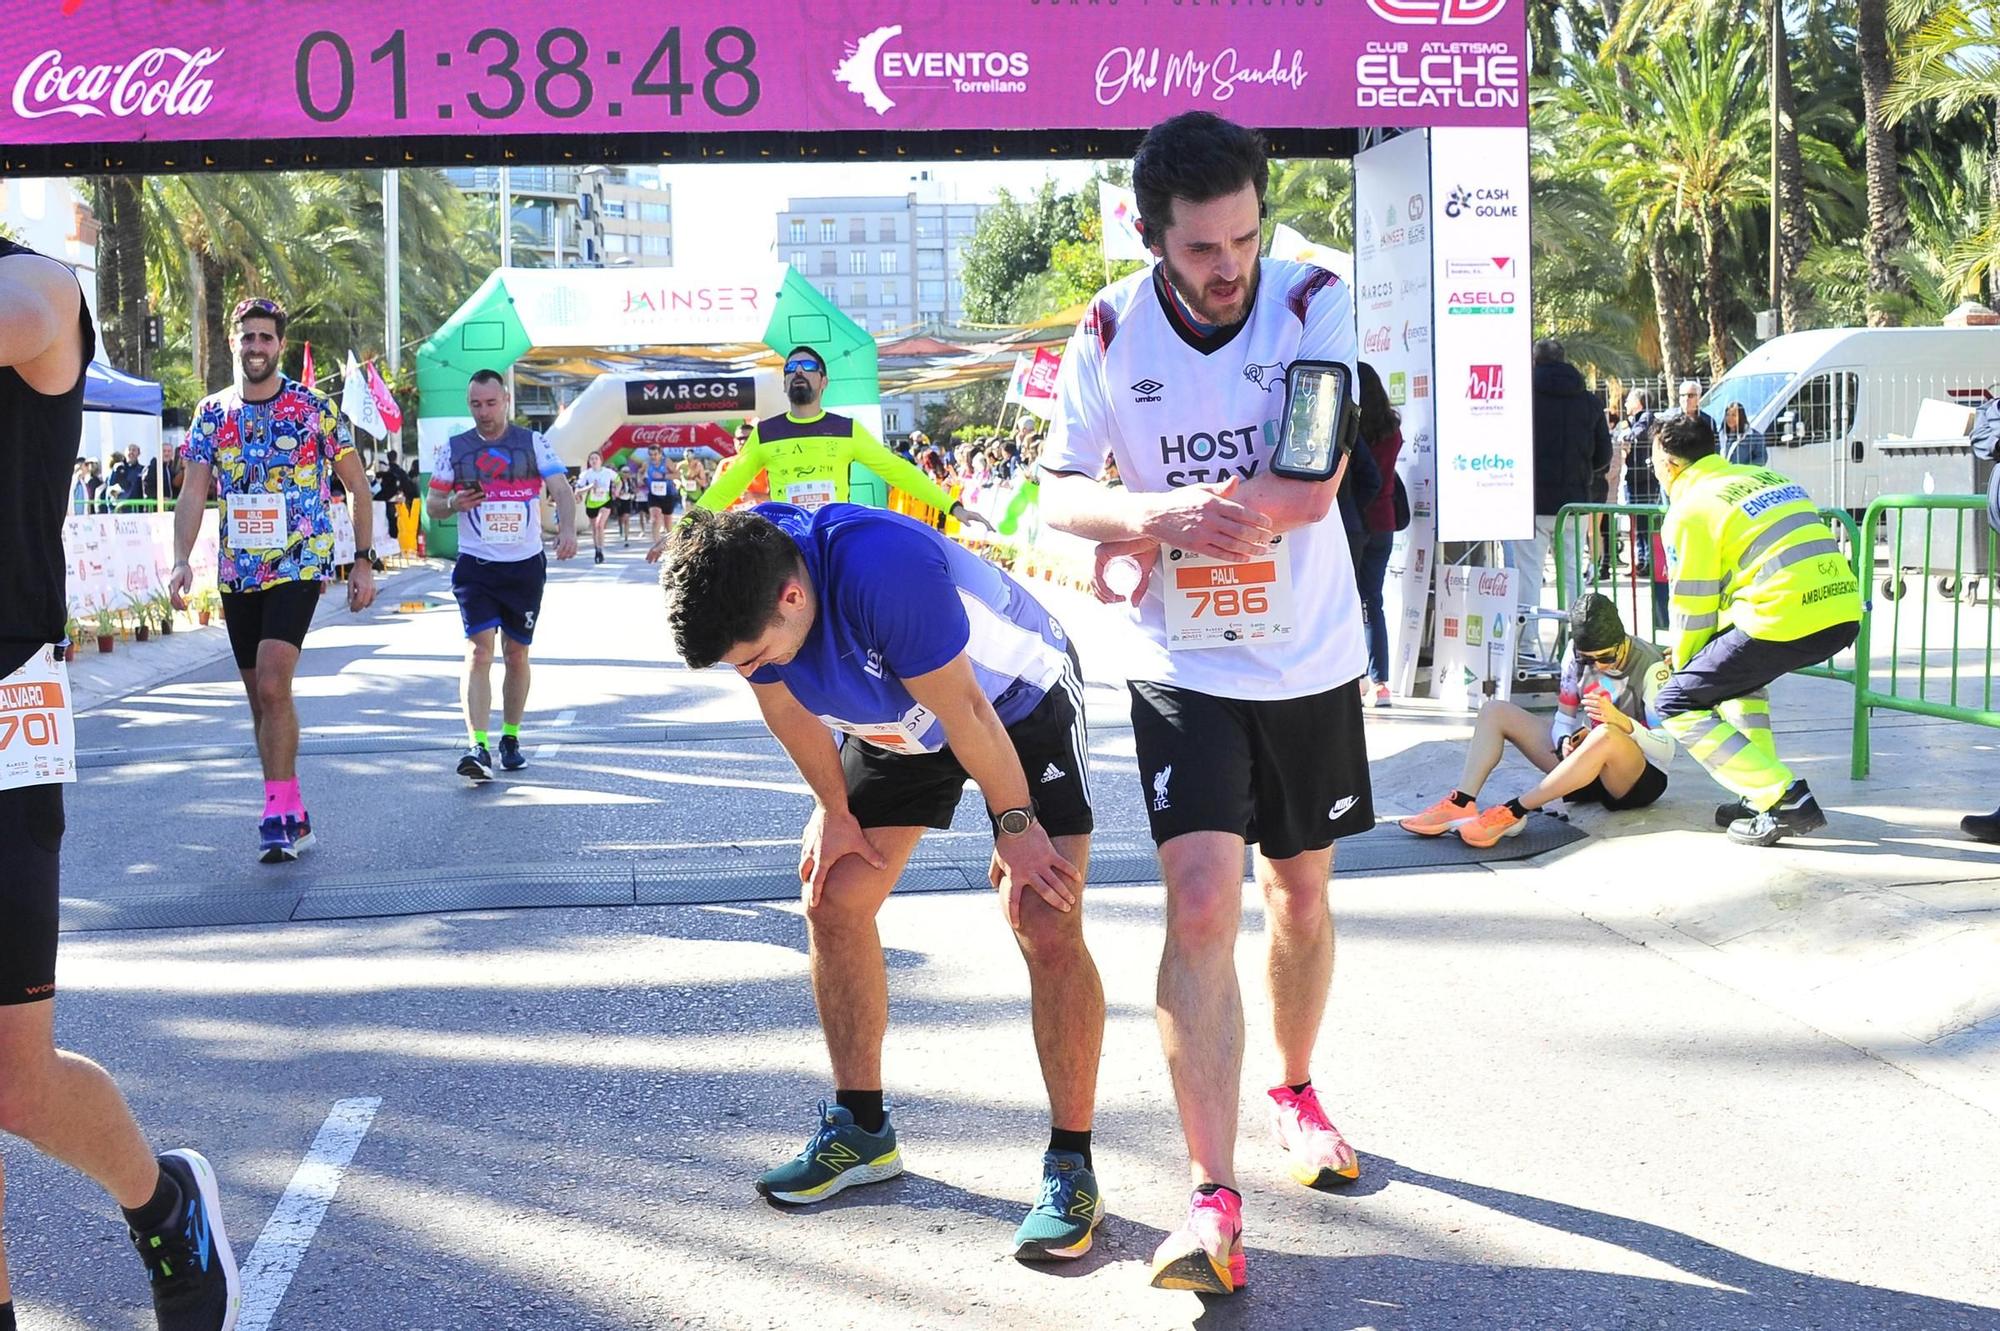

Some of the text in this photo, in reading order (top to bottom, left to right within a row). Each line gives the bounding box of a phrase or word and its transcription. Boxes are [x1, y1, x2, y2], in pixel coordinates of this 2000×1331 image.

[1366, 41, 1508, 55] CLUB ATLETISMO
[295, 26, 762, 121] 01:38:48
[883, 52, 1030, 77] EVENTOS
[1162, 49, 1211, 97] My
[1212, 47, 1308, 101] Sandals
[1356, 54, 1519, 87] ELCHE
[12, 46, 225, 118] Coca-Cola
[952, 78, 1027, 93] Torrellano
[1356, 87, 1520, 108] DECATLON
[1475, 188, 1510, 200] CASH
[1475, 205, 1518, 217] GOLME
[623, 287, 758, 313] JAINSER
[1448, 291, 1515, 304] ASELO
[643, 382, 739, 401] MARCOS
[1135, 394, 1162, 403] umbro
[1160, 425, 1258, 464] HOST
[1471, 453, 1514, 471] elche
[238, 521, 274, 534] 923
[488, 522, 519, 533] 426
[1210, 567, 1240, 586] PAUL
[1186, 586, 1268, 619] 786
[0, 712, 58, 751] 701
[1040, 770, 1066, 783] adidas
[1333, 795, 1354, 811] NIKE
